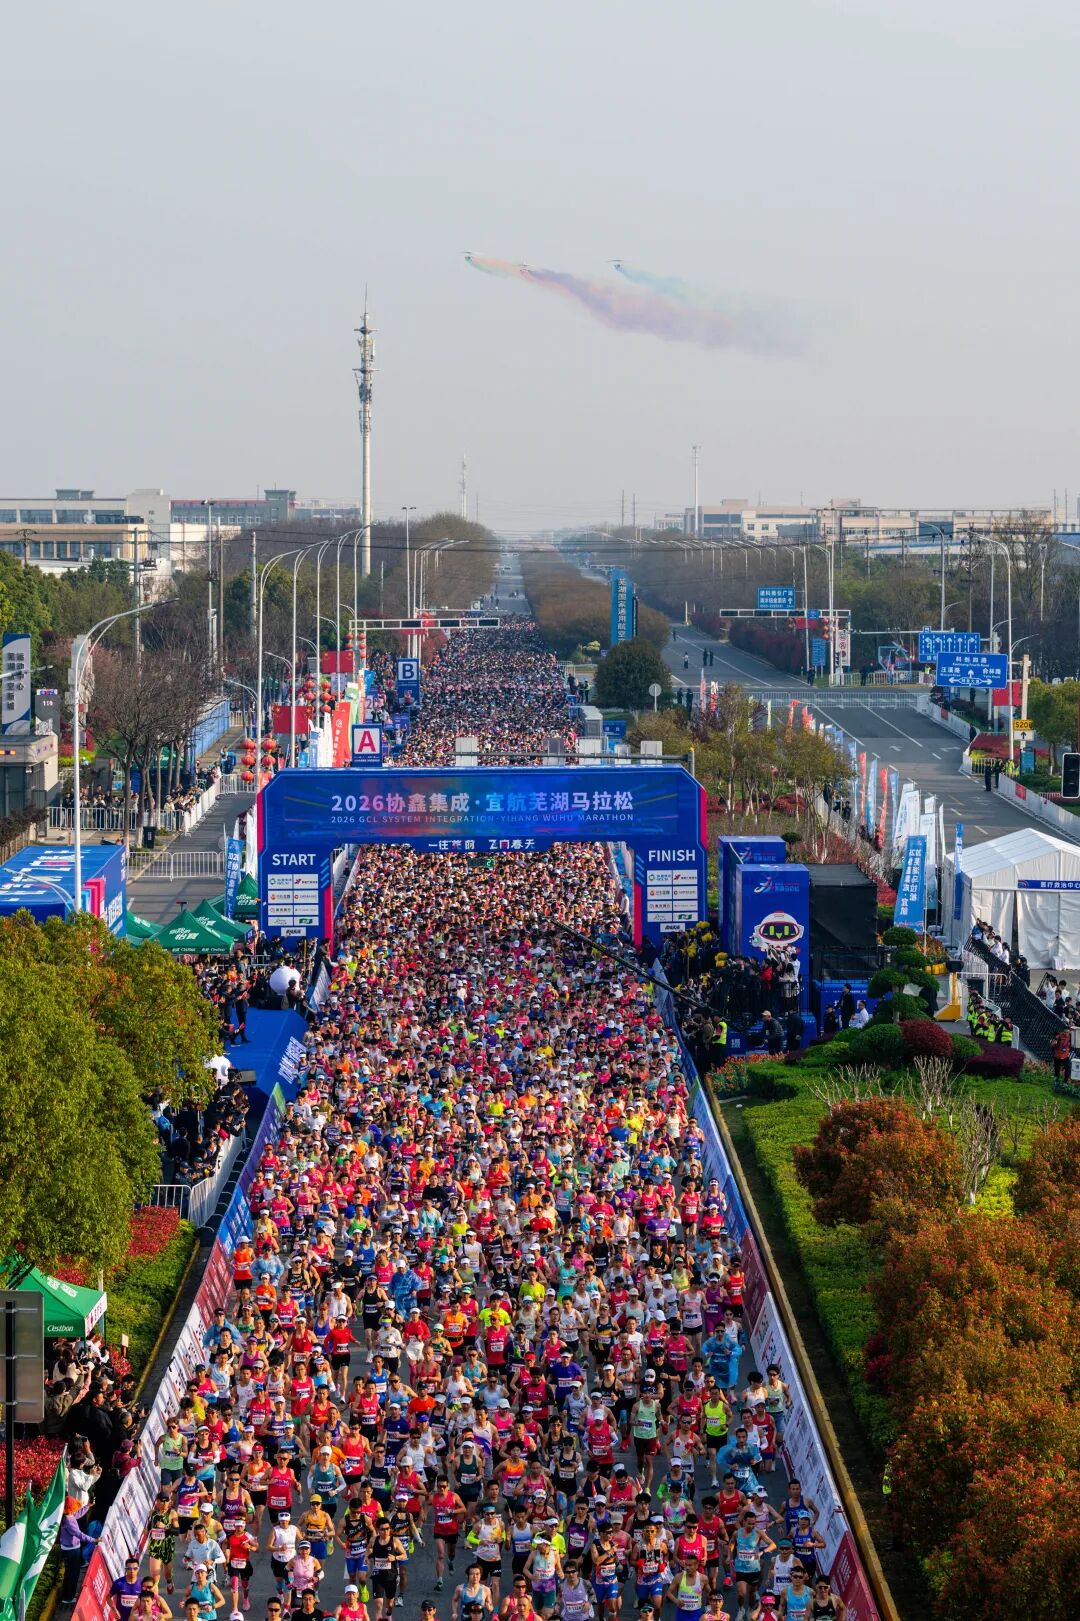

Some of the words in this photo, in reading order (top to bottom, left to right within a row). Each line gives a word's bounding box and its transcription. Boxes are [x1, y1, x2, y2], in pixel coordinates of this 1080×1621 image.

[402, 664, 414, 679] B
[358, 731, 376, 752] A
[331, 791, 634, 813] 2026协鑫集成·宜航芜湖马拉松
[382, 815, 421, 823] SYSTEM
[542, 814, 574, 822] WUHU
[577, 813, 634, 821] MARATHON
[272, 853, 316, 866] START
[648, 849, 696, 862] FINISH
